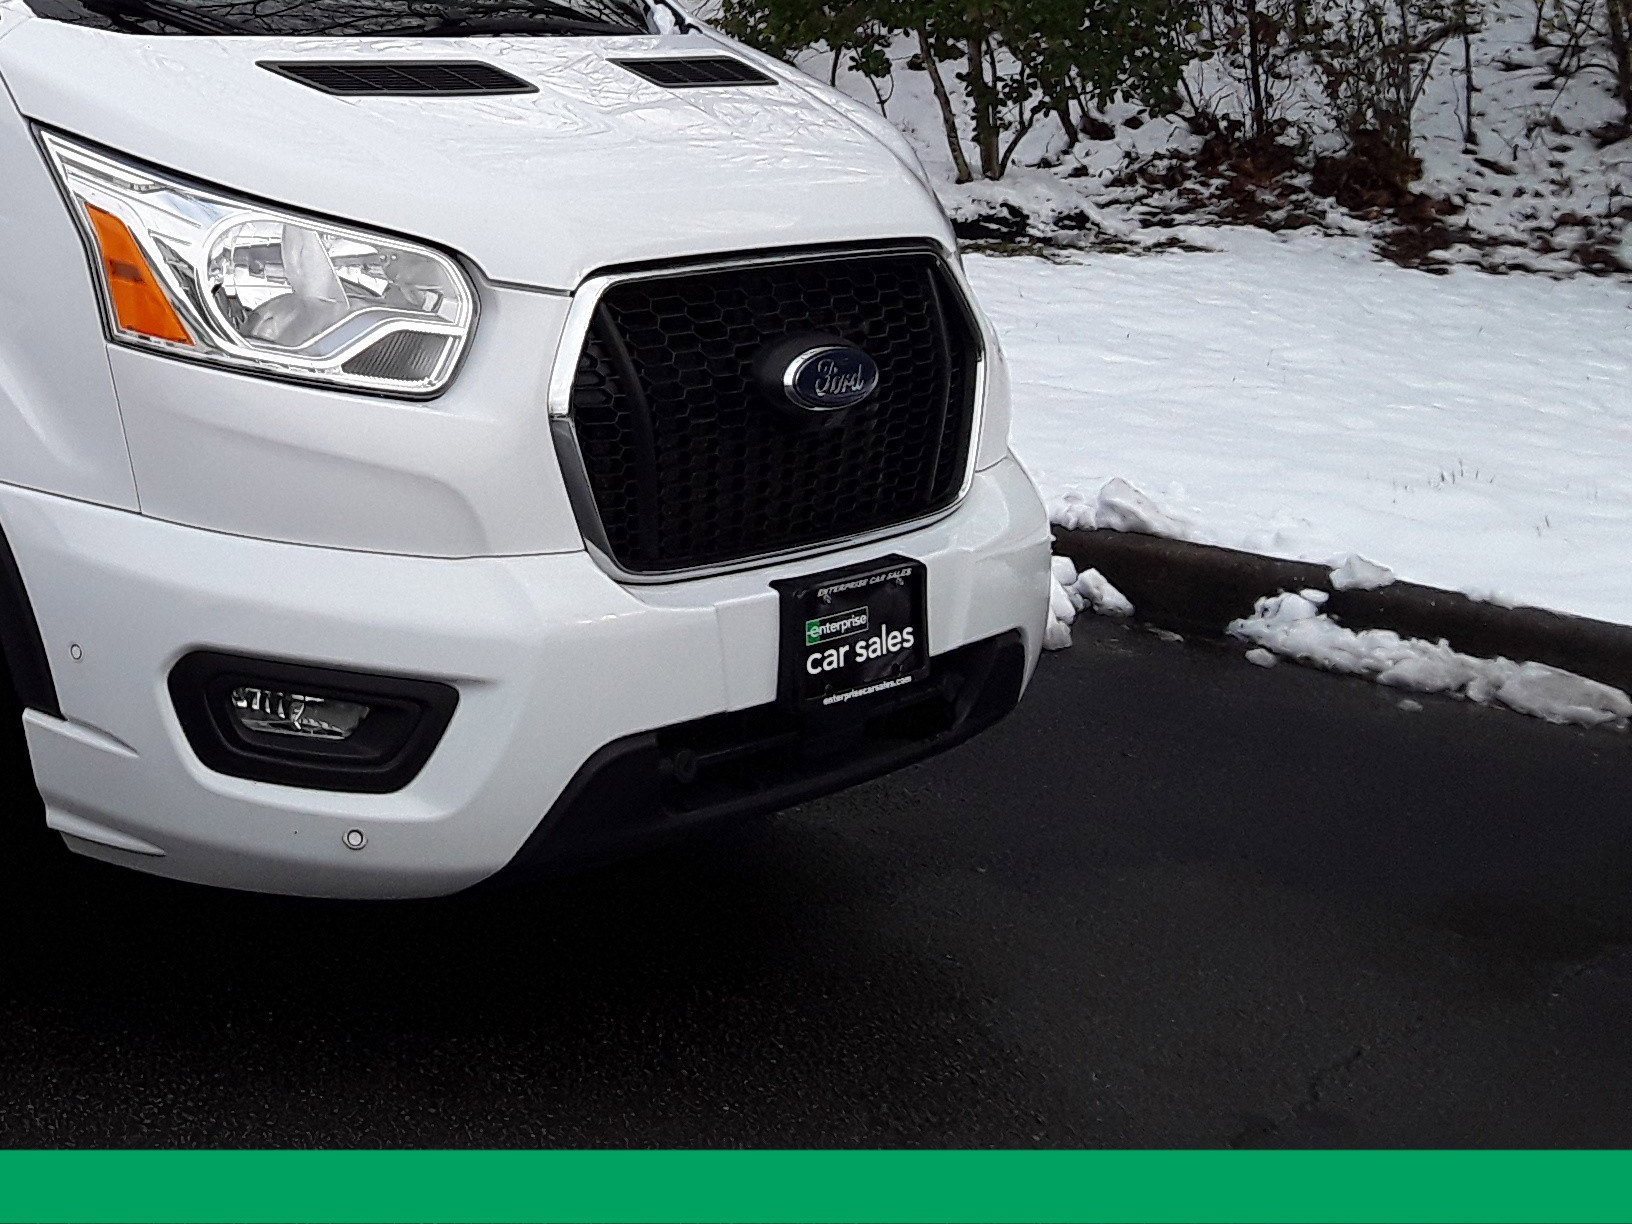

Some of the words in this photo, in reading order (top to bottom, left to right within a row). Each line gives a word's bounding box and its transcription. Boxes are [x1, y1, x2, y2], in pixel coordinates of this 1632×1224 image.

[815, 359, 865, 396] Ford
[807, 614, 867, 638] enterprise
[806, 645, 850, 675] car
[855, 624, 915, 663] sales
